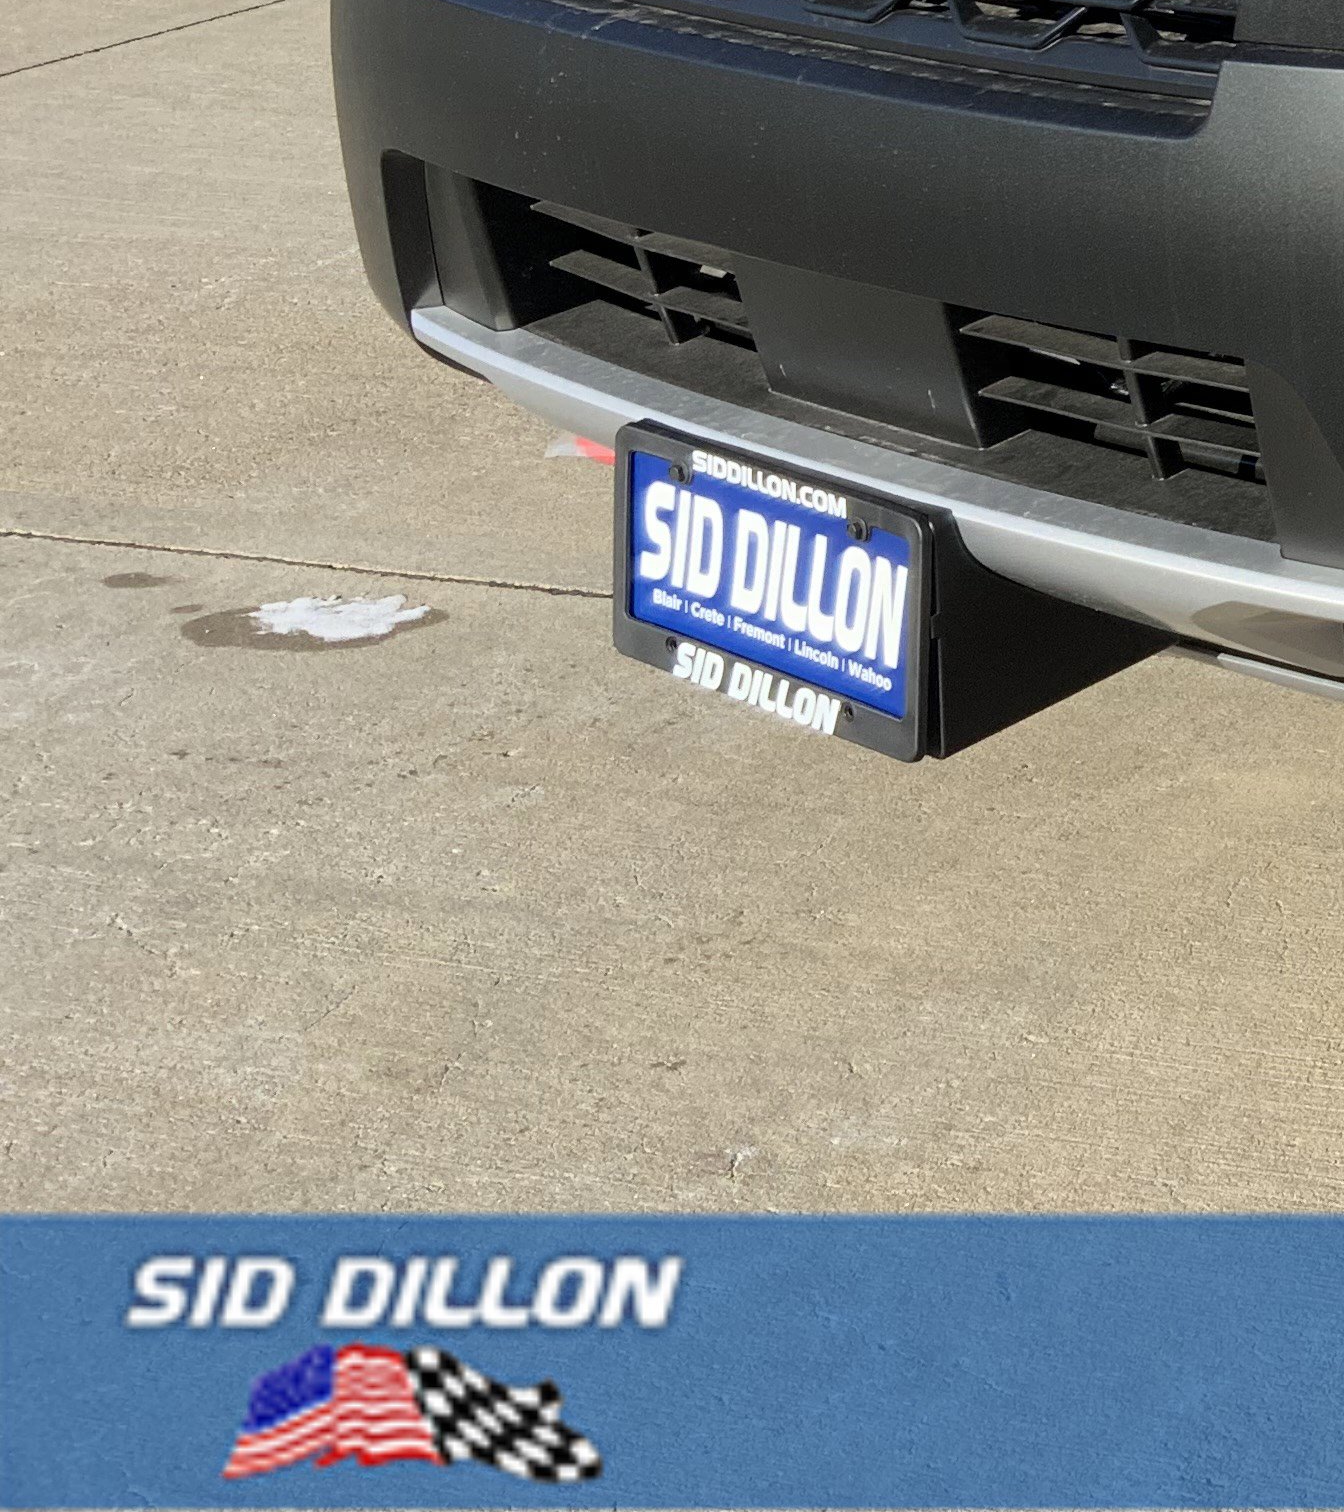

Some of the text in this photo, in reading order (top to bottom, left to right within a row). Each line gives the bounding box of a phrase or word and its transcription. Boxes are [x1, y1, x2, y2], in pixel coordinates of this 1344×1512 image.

[692, 449, 848, 520] SIDDILLON.COM
[639, 480, 909, 670] SID DILLON
[652, 588, 893, 691] Blair Crete Fremont Lincoln Wahoo
[672, 641, 842, 736] SID DILLON
